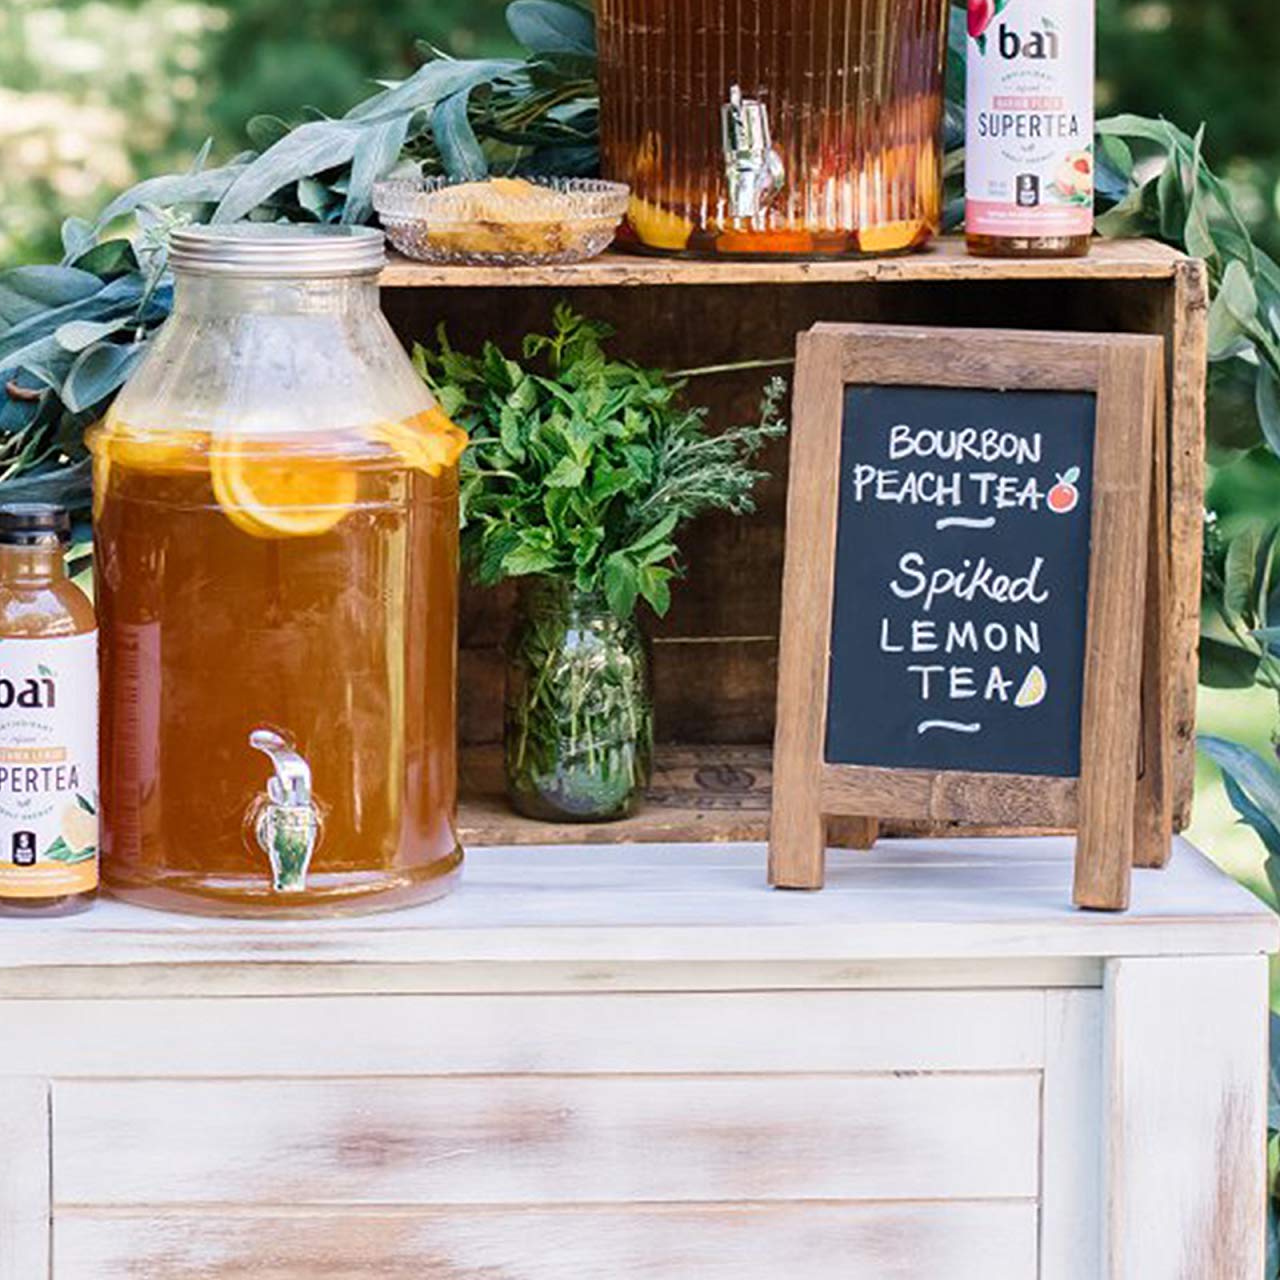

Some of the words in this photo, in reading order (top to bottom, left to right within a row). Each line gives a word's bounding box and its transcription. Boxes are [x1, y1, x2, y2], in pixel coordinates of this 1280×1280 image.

[999, 17, 1059, 60] bai
[977, 112, 1079, 138] SUPERTEA
[889, 424, 1041, 464] BOURBON
[853, 463, 962, 507] PEACH
[969, 471, 1046, 511] TEA
[889, 551, 1049, 611] Spiked
[880, 618, 1041, 654] LEMON
[907, 665, 1015, 702] TEA
